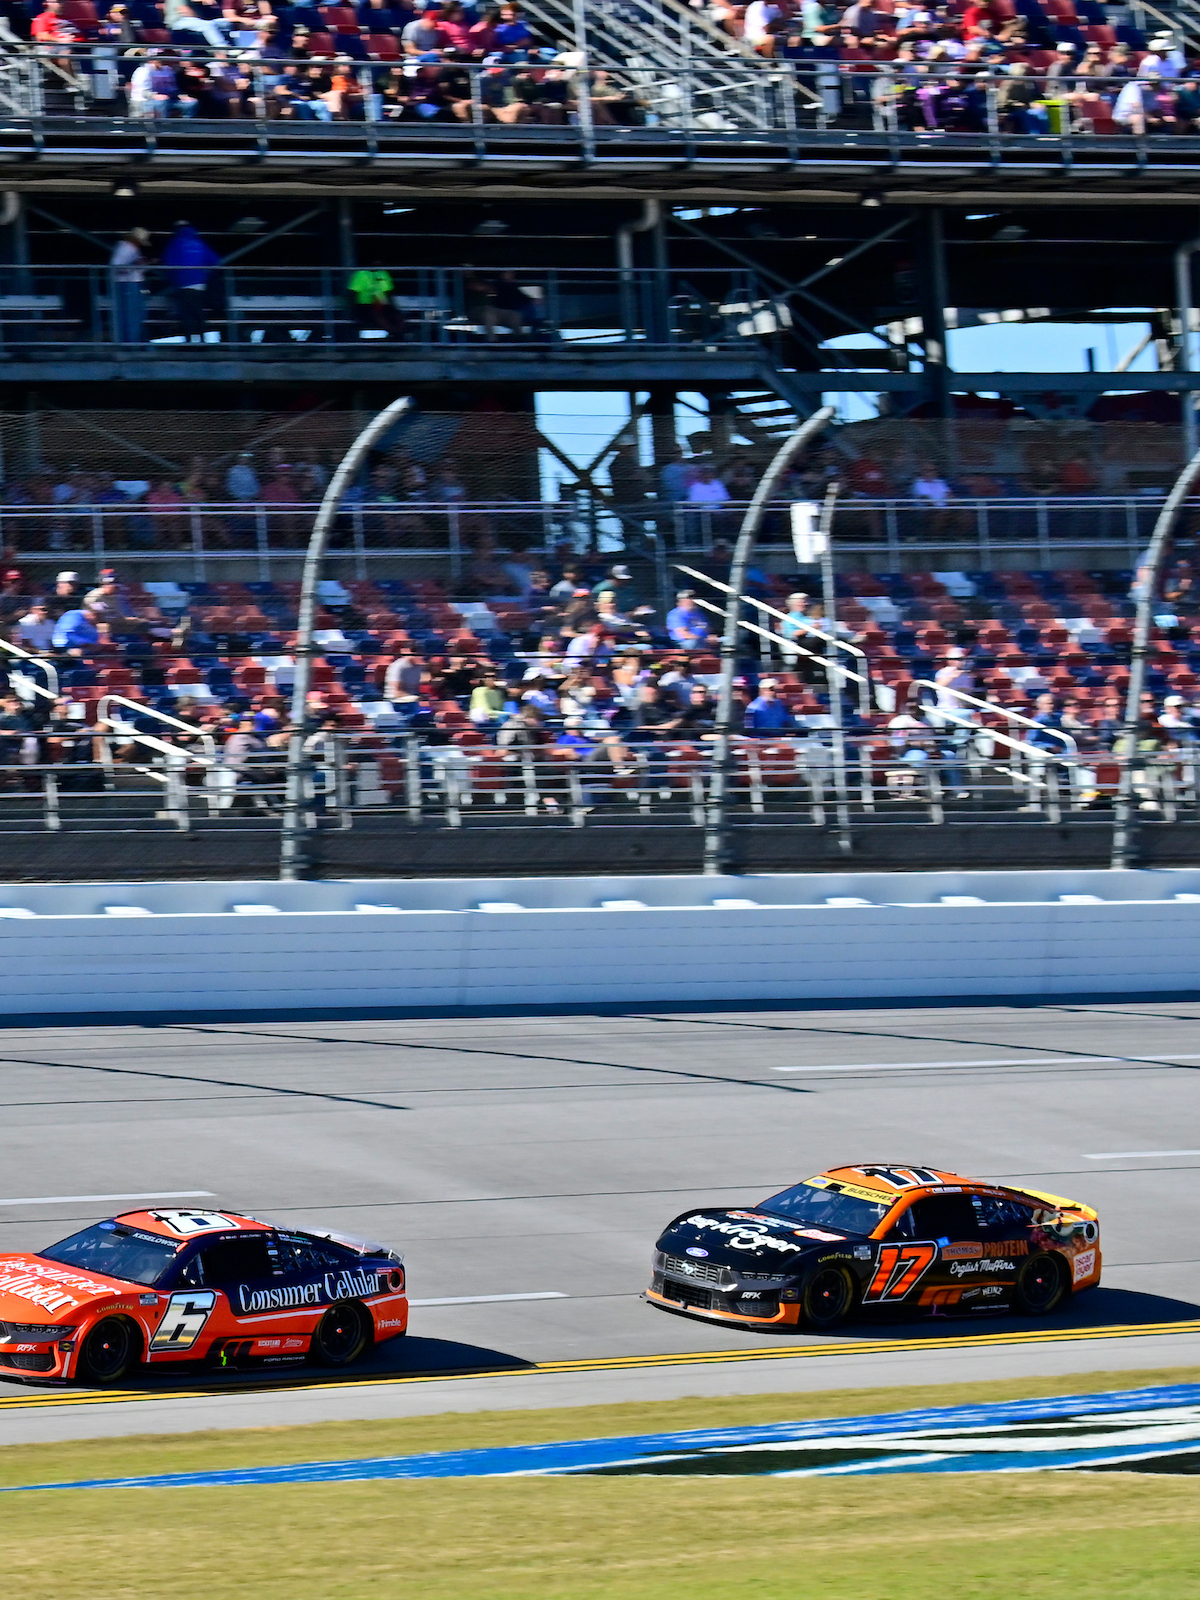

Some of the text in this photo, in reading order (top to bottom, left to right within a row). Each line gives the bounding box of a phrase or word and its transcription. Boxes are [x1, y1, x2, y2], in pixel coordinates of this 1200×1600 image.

[132, 1232, 181, 1248] KESELOWSK
[983, 1240, 1030, 1258] PROTEIN
[817, 1251, 853, 1264] GOODYEAR
[863, 1241, 939, 1304] 17
[950, 1259, 1017, 1278] English Muffins
[238, 1268, 384, 1313] Consumer Cellular
[741, 1291, 762, 1300] RFK
[982, 1286, 1004, 1296] HEINZ
[96, 1302, 134, 1314] GOODYEAR
[149, 1288, 218, 1352] 6
[381, 1318, 402, 1329] Trimble
[17, 1343, 37, 1352] RFK
